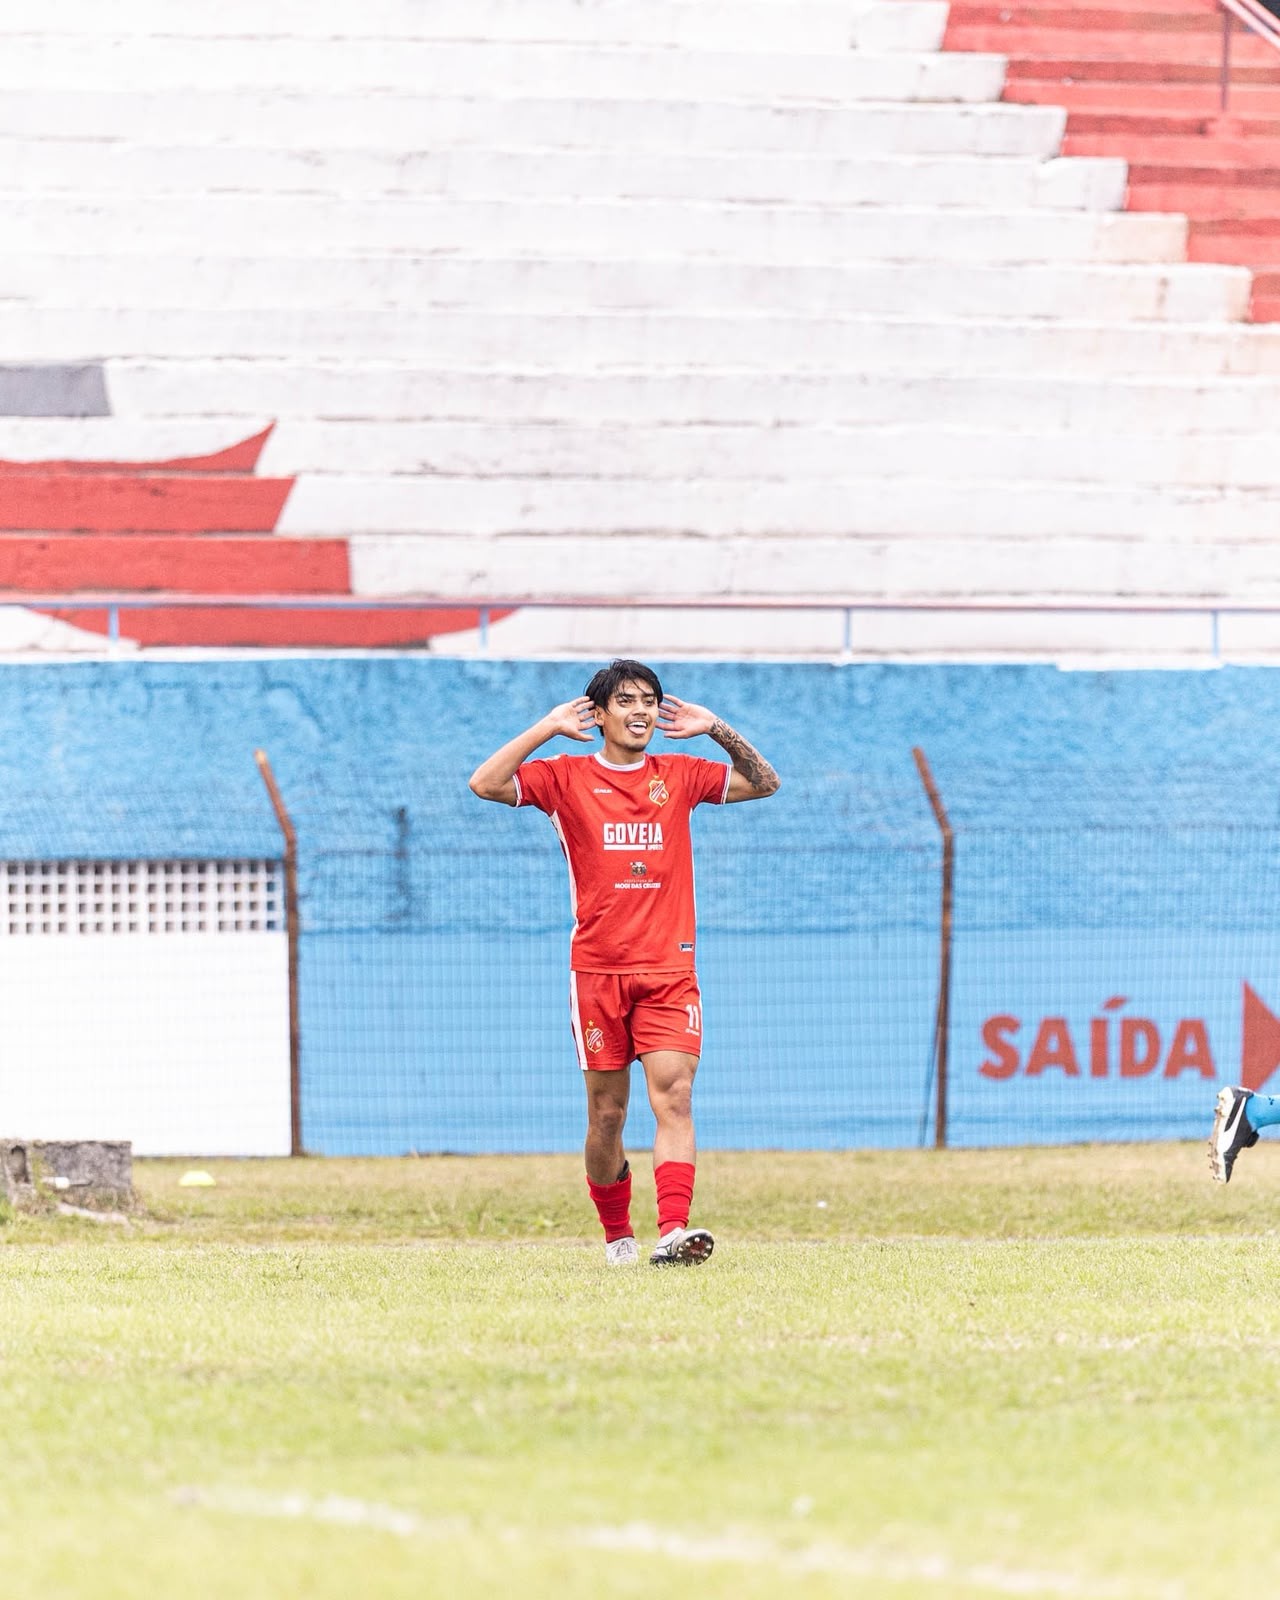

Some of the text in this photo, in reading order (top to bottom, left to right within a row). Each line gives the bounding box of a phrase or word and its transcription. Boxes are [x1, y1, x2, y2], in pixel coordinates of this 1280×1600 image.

[603, 822, 663, 844] GOVEIA
[685, 1003, 699, 1030] 11
[979, 996, 1216, 1081] SAÍDA
